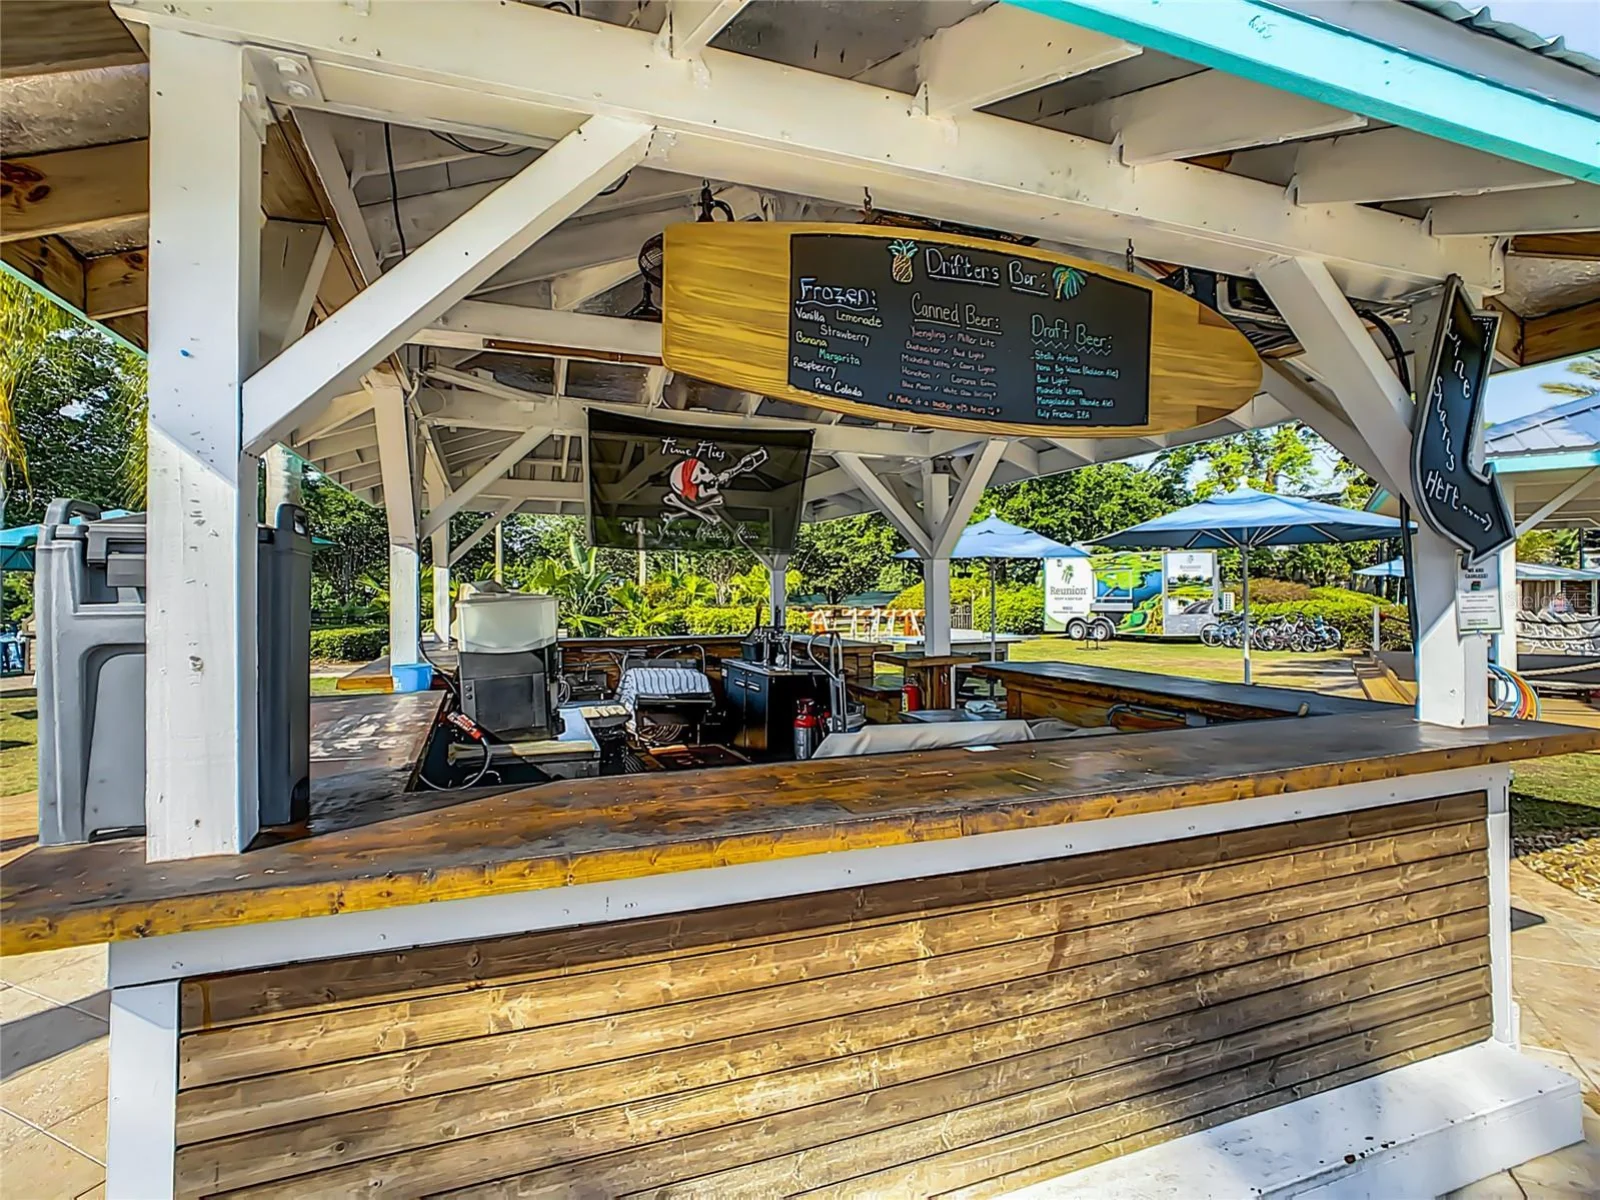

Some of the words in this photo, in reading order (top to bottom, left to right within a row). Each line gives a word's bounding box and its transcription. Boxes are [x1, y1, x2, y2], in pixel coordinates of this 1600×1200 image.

[1008, 260, 1047, 289] Bar:
[799, 277, 877, 305] Frozen:
[795, 307, 826, 323] Vanilla
[836, 310, 883, 327] Lemonade
[911, 292, 960, 324] Canned
[965, 304, 1000, 329] Beer:
[795, 330, 828, 347] Banana
[820, 324, 870, 347] Strawberry
[957, 333, 977, 345] Miller
[980, 339, 996, 348] Lite
[1031, 314, 1070, 340] Draft
[1075, 323, 1112, 349] Beer:
[818, 349, 861, 365] Margarita
[905, 340, 941, 354] Budweiser
[953, 347, 965, 357] Bud
[968, 350, 985, 361] Light
[1057, 352, 1079, 363] Artois
[792, 356, 836, 379] Raspberry
[833, 381, 863, 397] Colada
[950, 375, 976, 386] Corona
[1051, 376, 1070, 386] Light
[661, 436, 692, 454] Time
[696, 440, 726, 460] Flies
[1424, 468, 1460, 511] Here
[1050, 585, 1087, 596] Reunion
